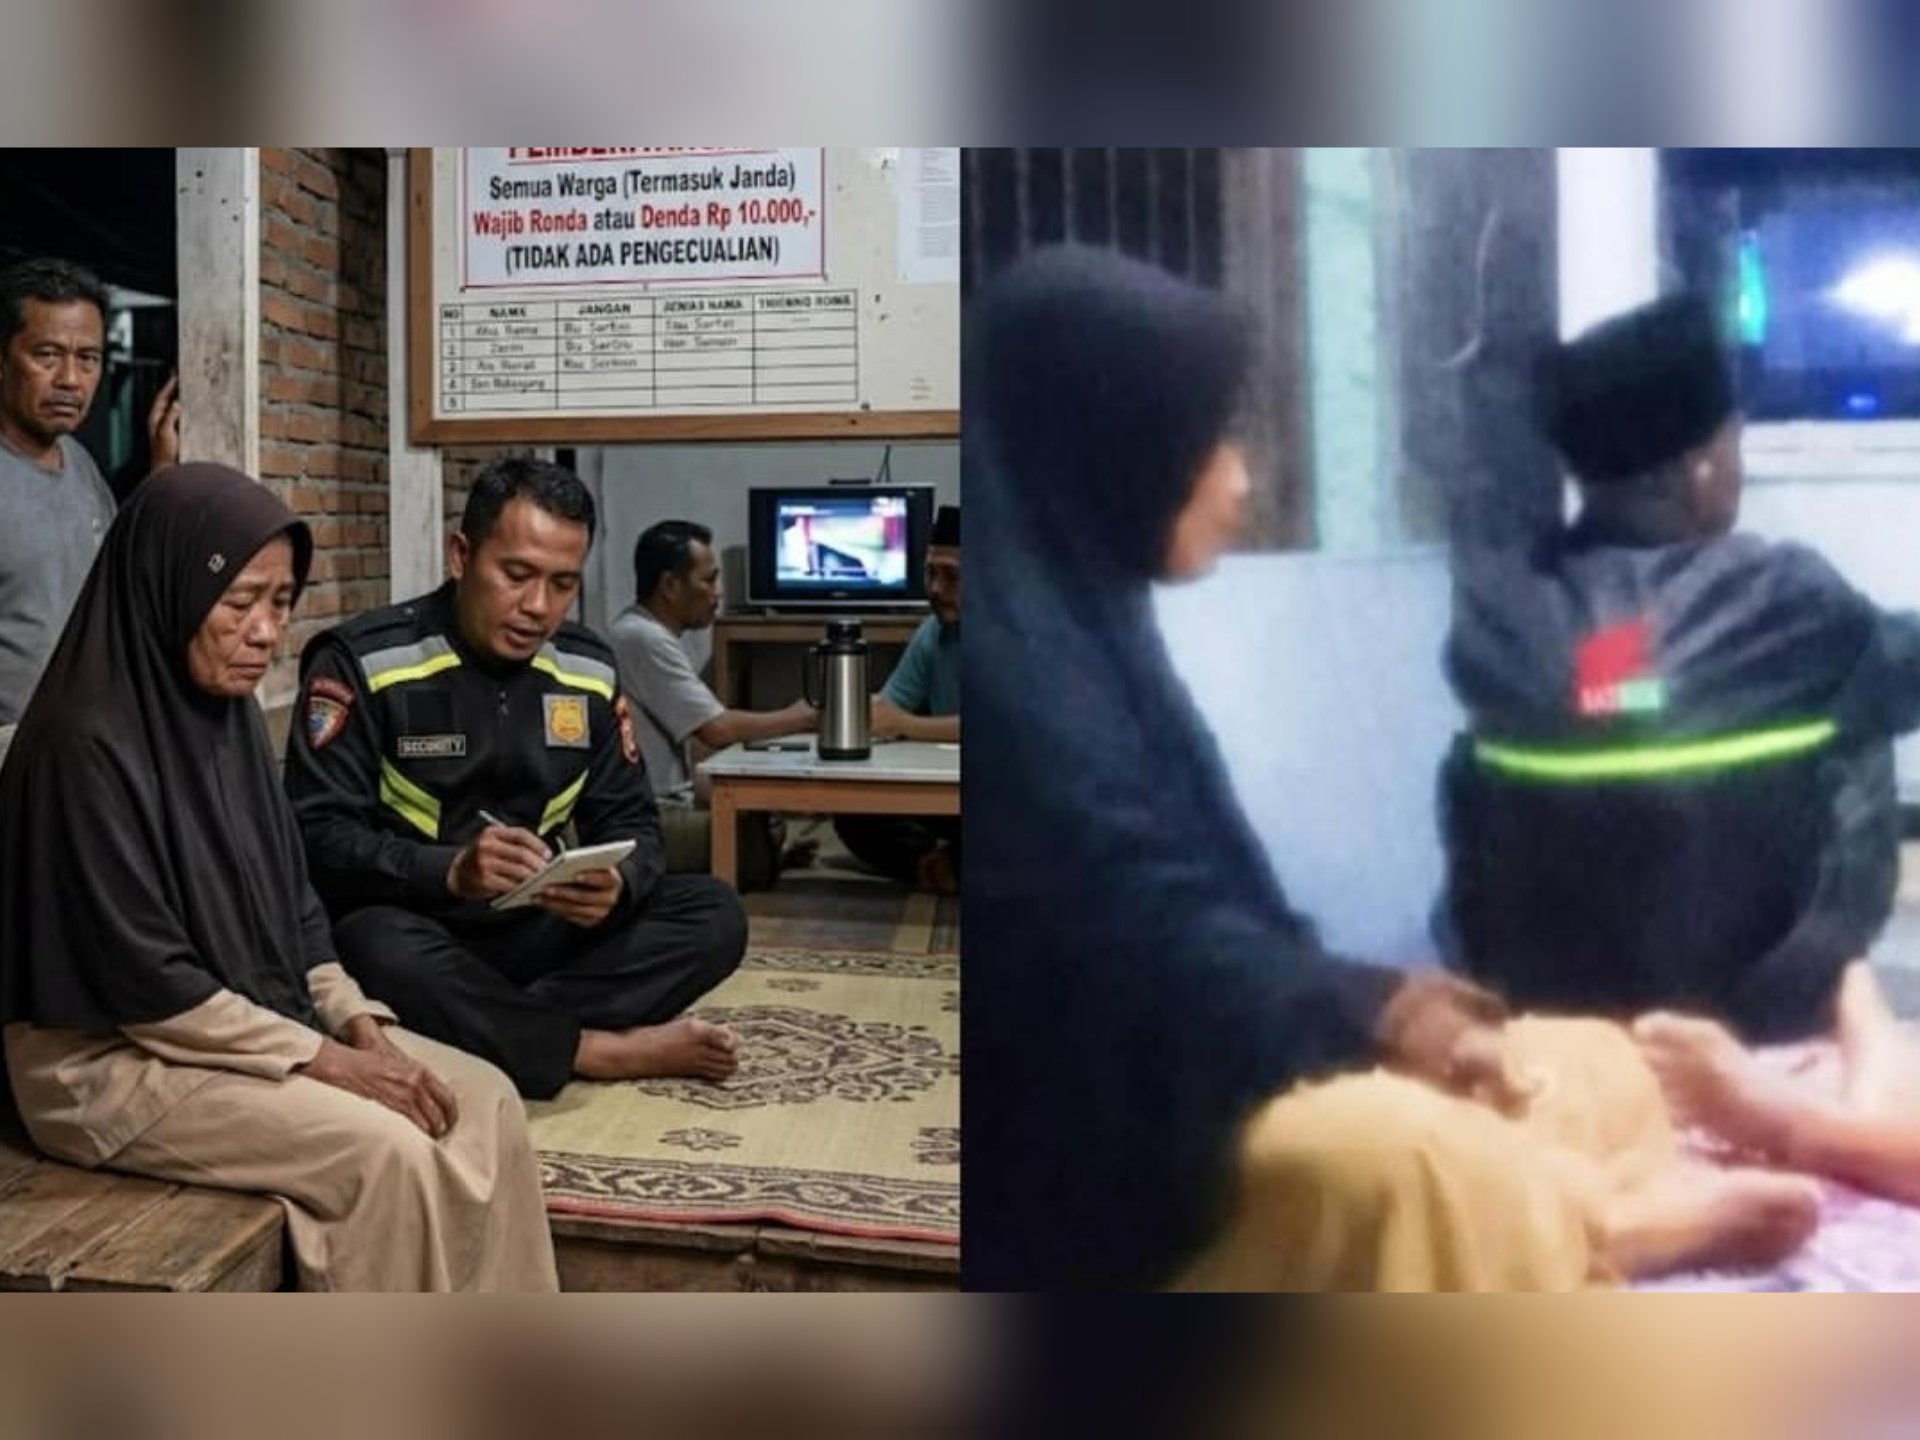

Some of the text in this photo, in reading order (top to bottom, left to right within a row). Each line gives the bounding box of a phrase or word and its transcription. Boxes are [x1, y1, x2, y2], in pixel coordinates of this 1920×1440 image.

[490, 161, 796, 201] Semua Warga (Termasuk Janda)
[473, 197, 816, 240] Wajib Ronda atau Denda Rp 10.000,-
[505, 236, 780, 276] (TIDAK ADA PENGECUALIAN)
